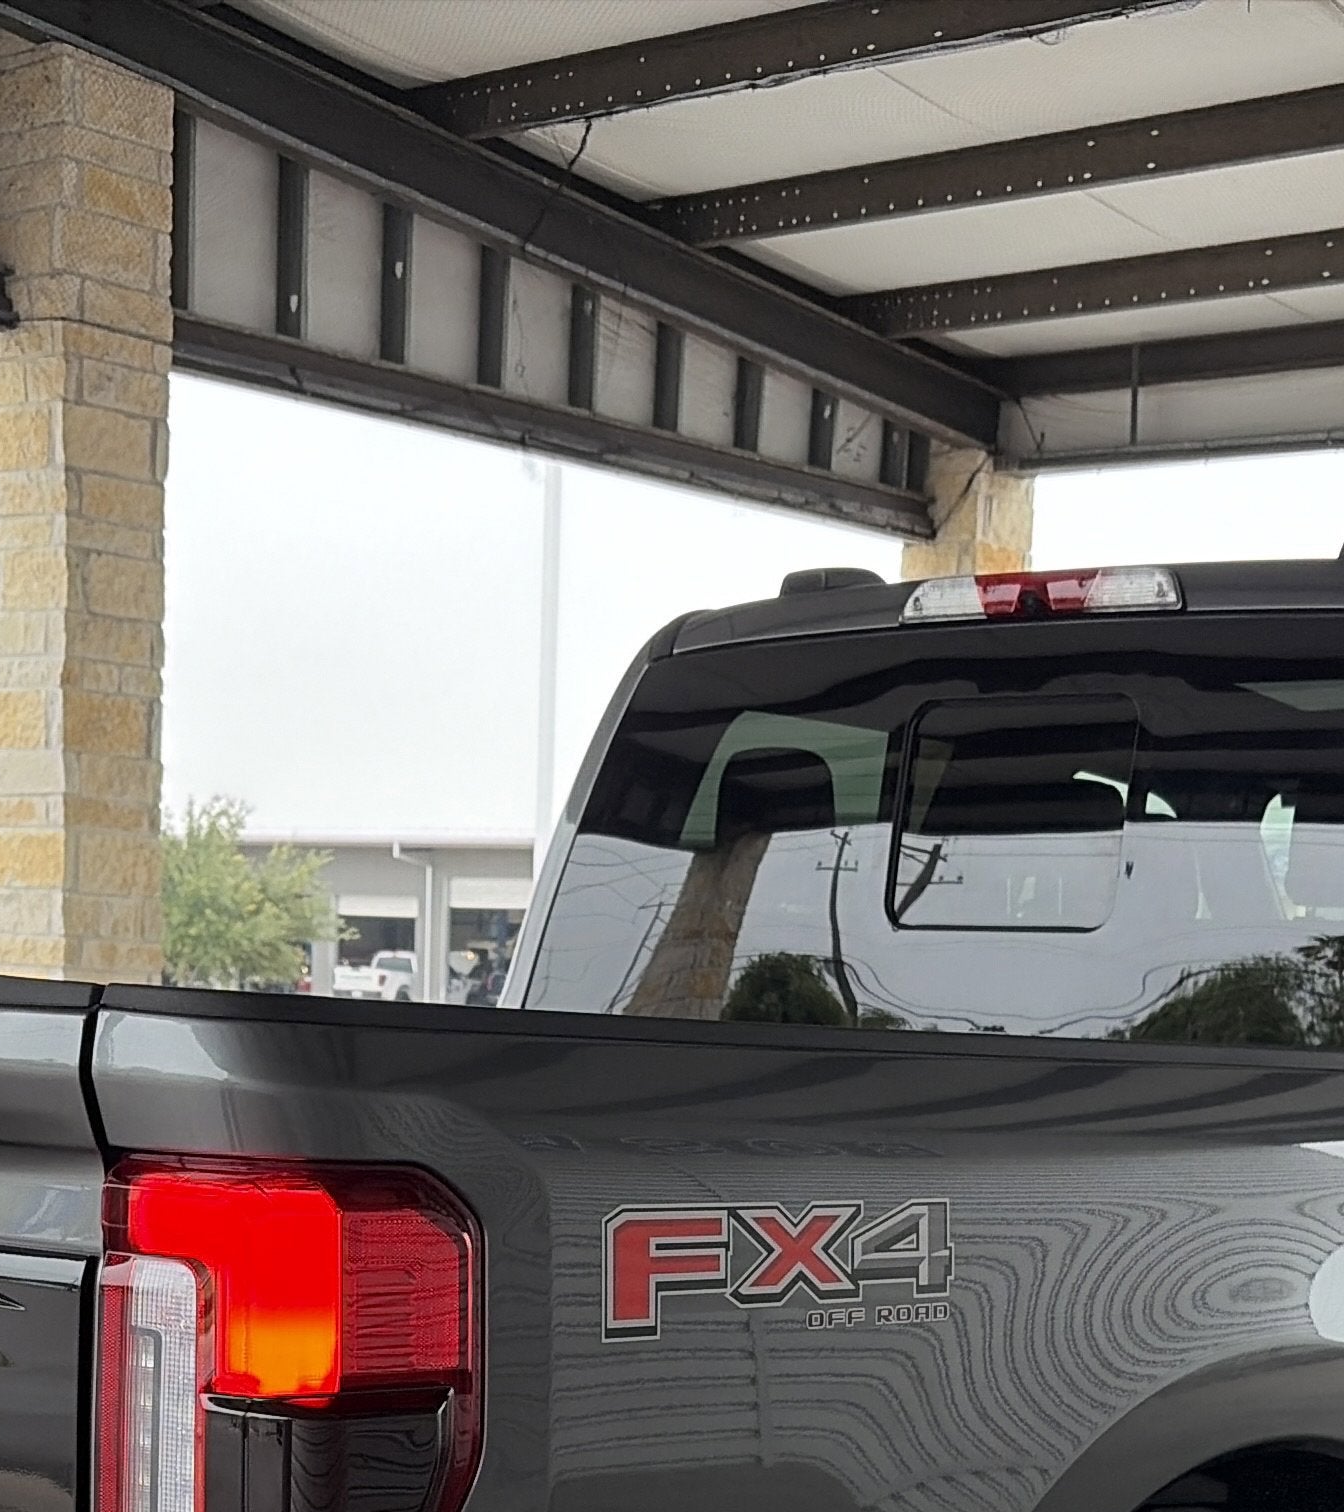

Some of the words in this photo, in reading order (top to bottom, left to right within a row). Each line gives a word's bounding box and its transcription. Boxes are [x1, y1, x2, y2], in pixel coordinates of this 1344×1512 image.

[601, 1198, 954, 1343] FX4
[807, 1308, 865, 1330] OFF
[876, 1302, 950, 1325] ROAD
